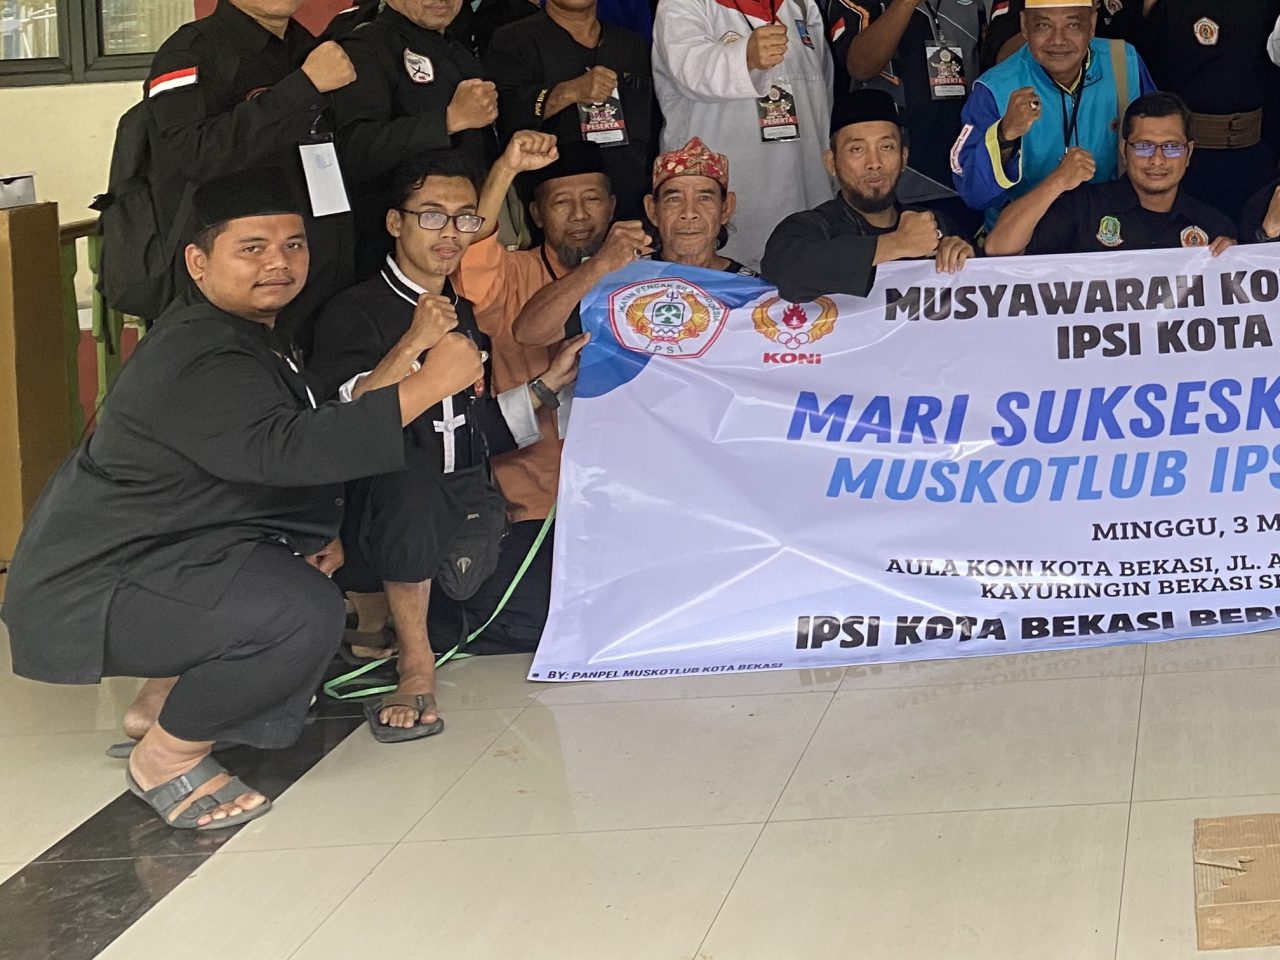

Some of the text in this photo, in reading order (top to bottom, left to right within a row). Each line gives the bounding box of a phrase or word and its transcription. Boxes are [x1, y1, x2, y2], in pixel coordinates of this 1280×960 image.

[586, 122, 620, 131] PESERTA
[763, 117, 794, 125] PESERTA
[636, 283, 673, 294] PENCAK
[884, 274, 1206, 322] MUSYAWARAH
[645, 341, 683, 354] IPSI
[1056, 322, 1142, 360] IPSI
[1156, 313, 1274, 355] KOTA
[763, 352, 822, 365] KONI
[786, 390, 970, 445] MARI
[825, 448, 1190, 504] MUSKOTLUB
[1091, 516, 1225, 542] MINGGU,
[1232, 515, 1249, 535] 3
[885, 558, 961, 577] AULA
[966, 558, 1034, 577] KONI
[1039, 559, 1113, 578] KOTA
[1118, 556, 1221, 578] BEKASI,
[1225, 554, 1262, 572] JL.
[980, 580, 1151, 601] KAYURINGIN
[1157, 574, 1254, 596] BEKASI
[794, 614, 882, 650] IPSI
[893, 615, 1008, 646] KOTA
[1020, 610, 1176, 641] BEKASI
[547, 661, 784, 680] BY: PANPEL MUSKOTLUB KOTA BEKASI
